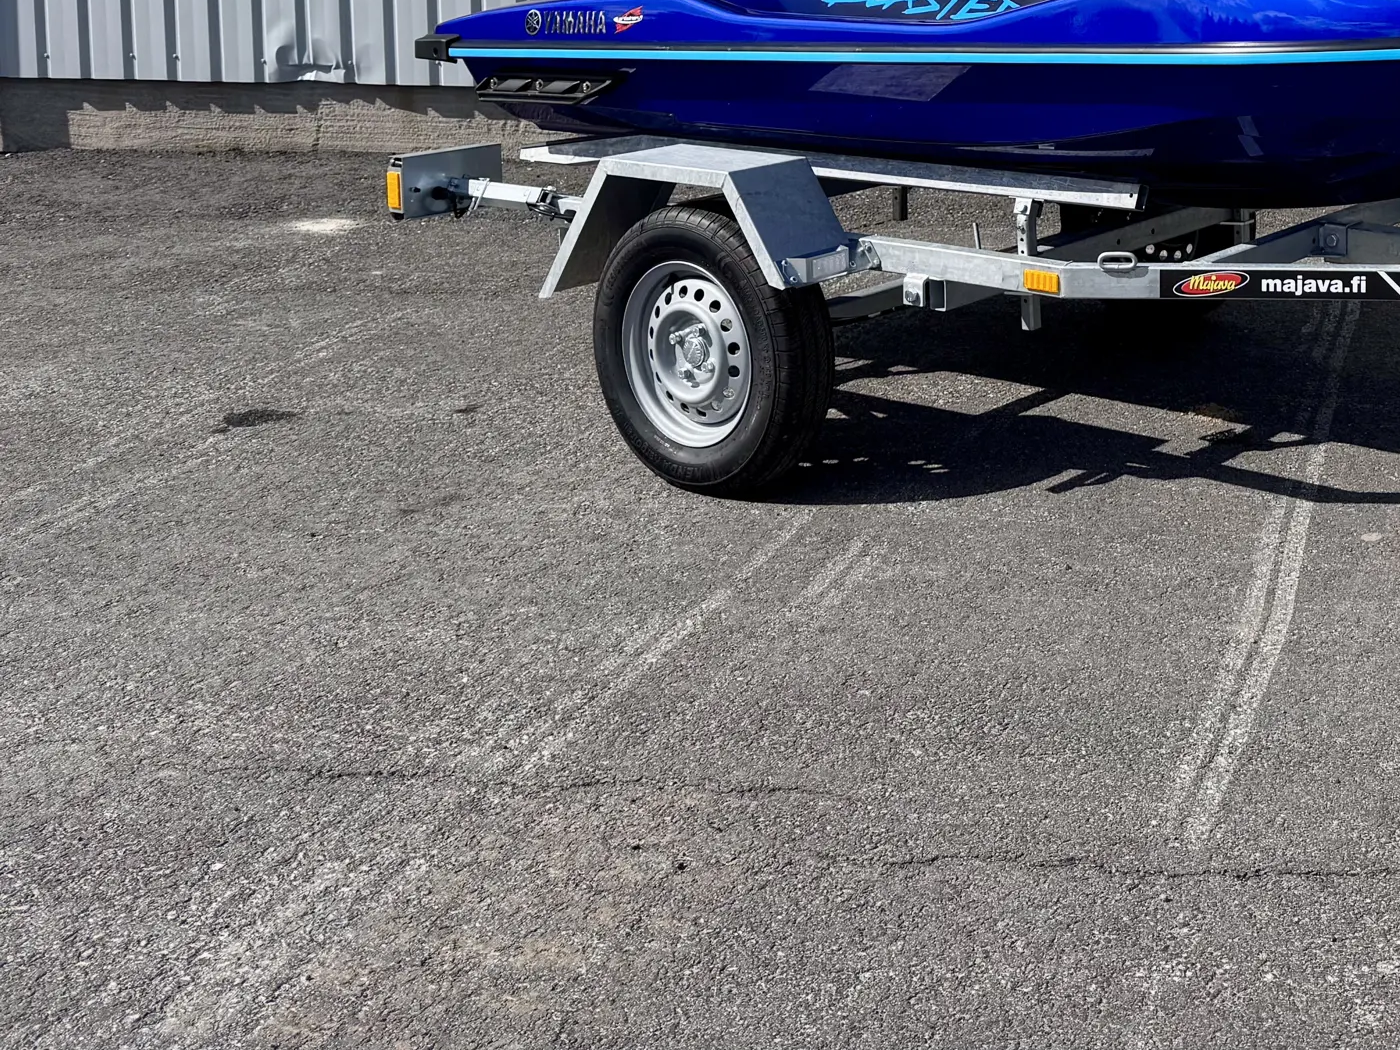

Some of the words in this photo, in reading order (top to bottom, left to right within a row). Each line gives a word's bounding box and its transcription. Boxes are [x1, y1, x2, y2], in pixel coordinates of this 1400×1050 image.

[543, 10, 607, 35] YAMAHA
[1188, 275, 1237, 293] Majava
[1260, 275, 1367, 296] majava.fi
